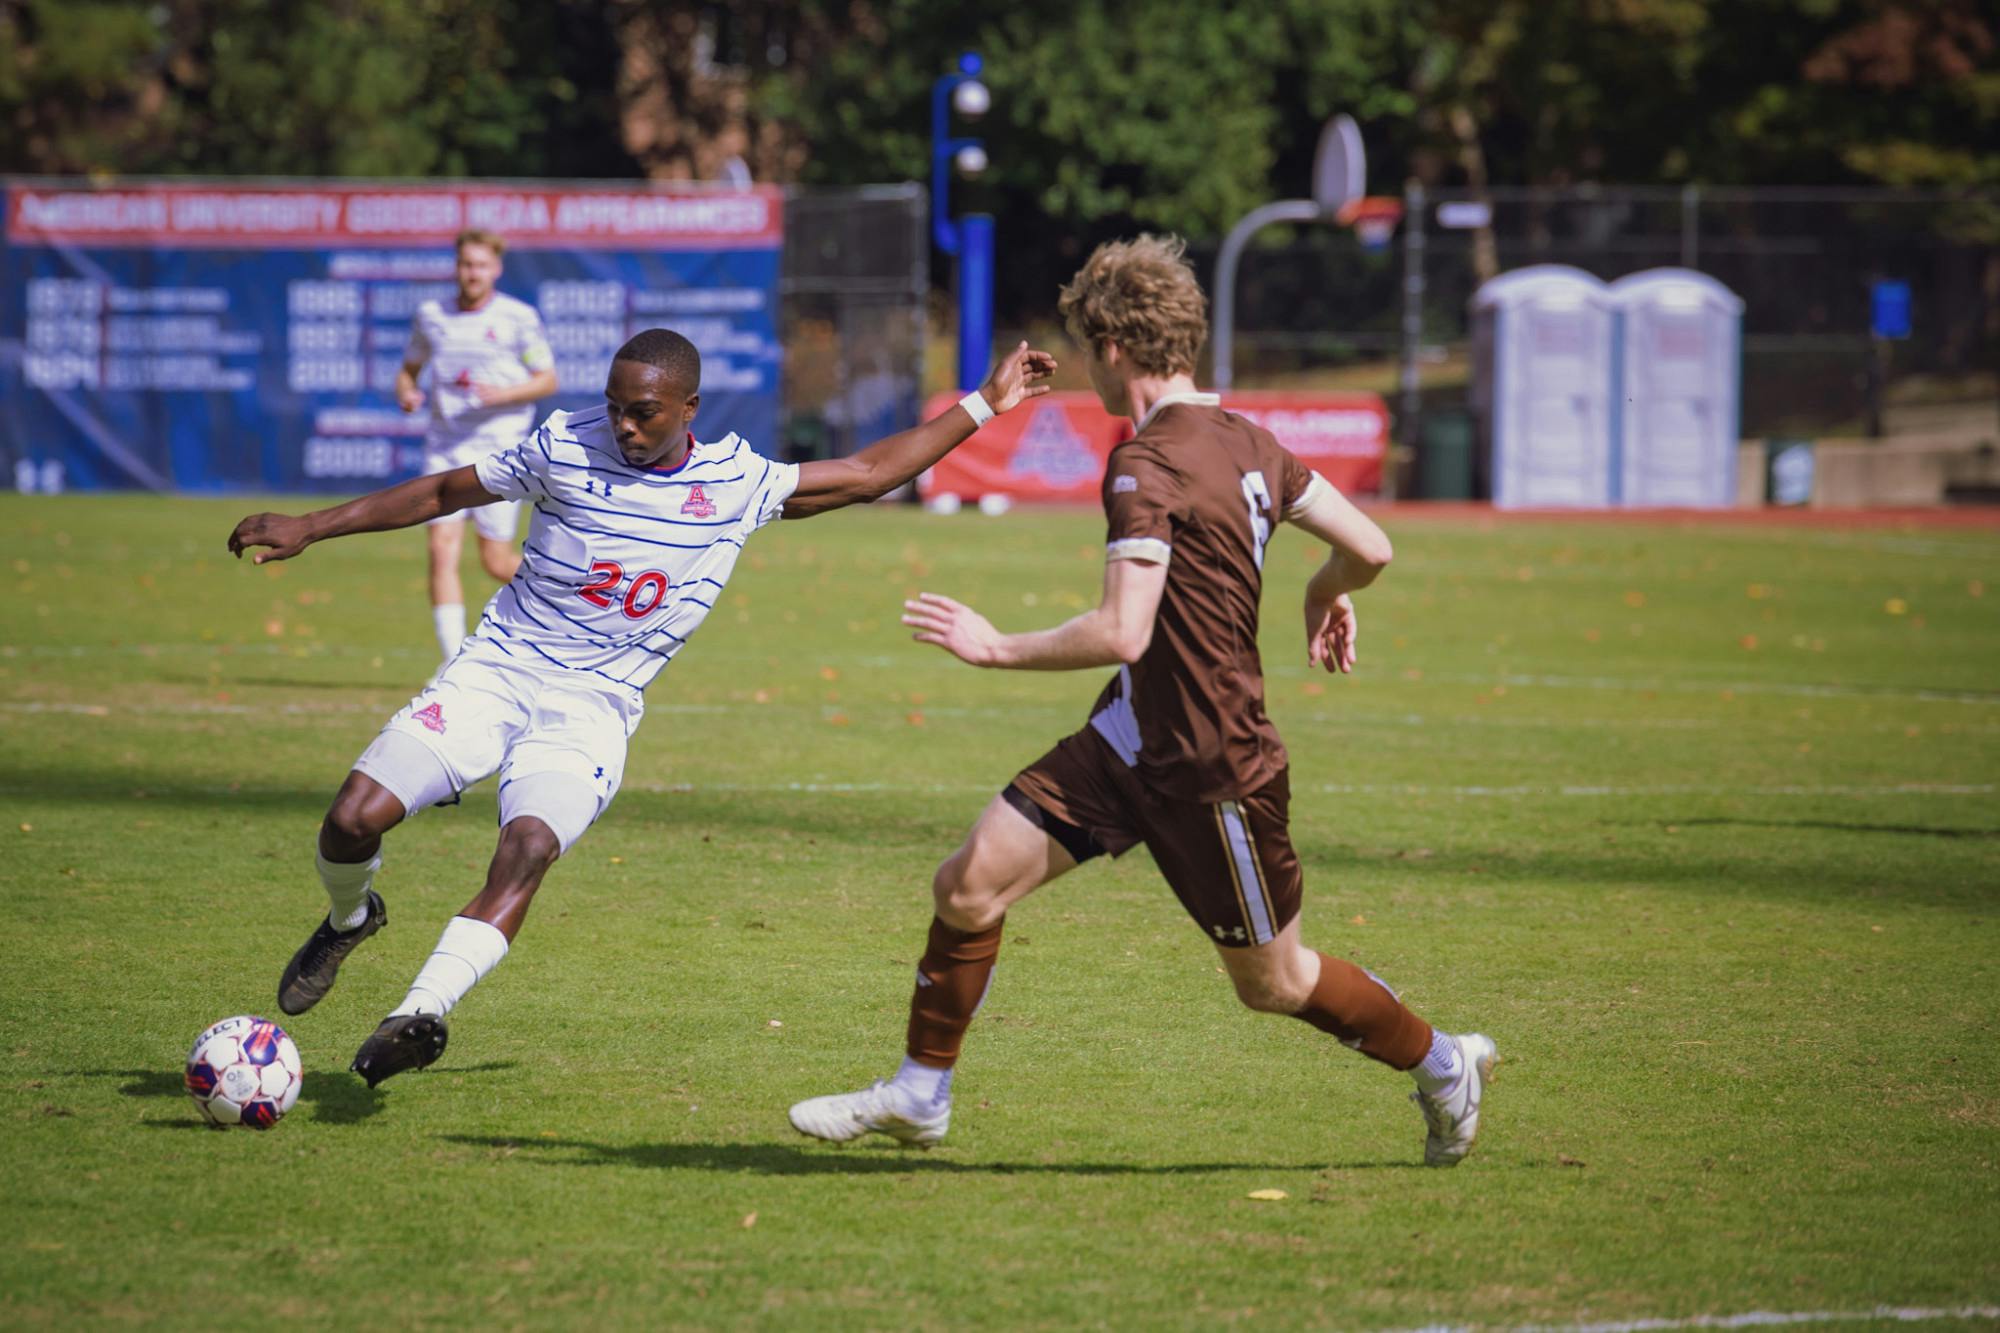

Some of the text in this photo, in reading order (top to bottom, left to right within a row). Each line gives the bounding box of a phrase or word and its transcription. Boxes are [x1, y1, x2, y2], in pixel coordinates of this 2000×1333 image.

[171, 193, 342, 231] UNIVERSITY
[466, 194, 550, 231] NCAA
[555, 195, 768, 232] APPEARANCES
[577, 557, 670, 621] 20
